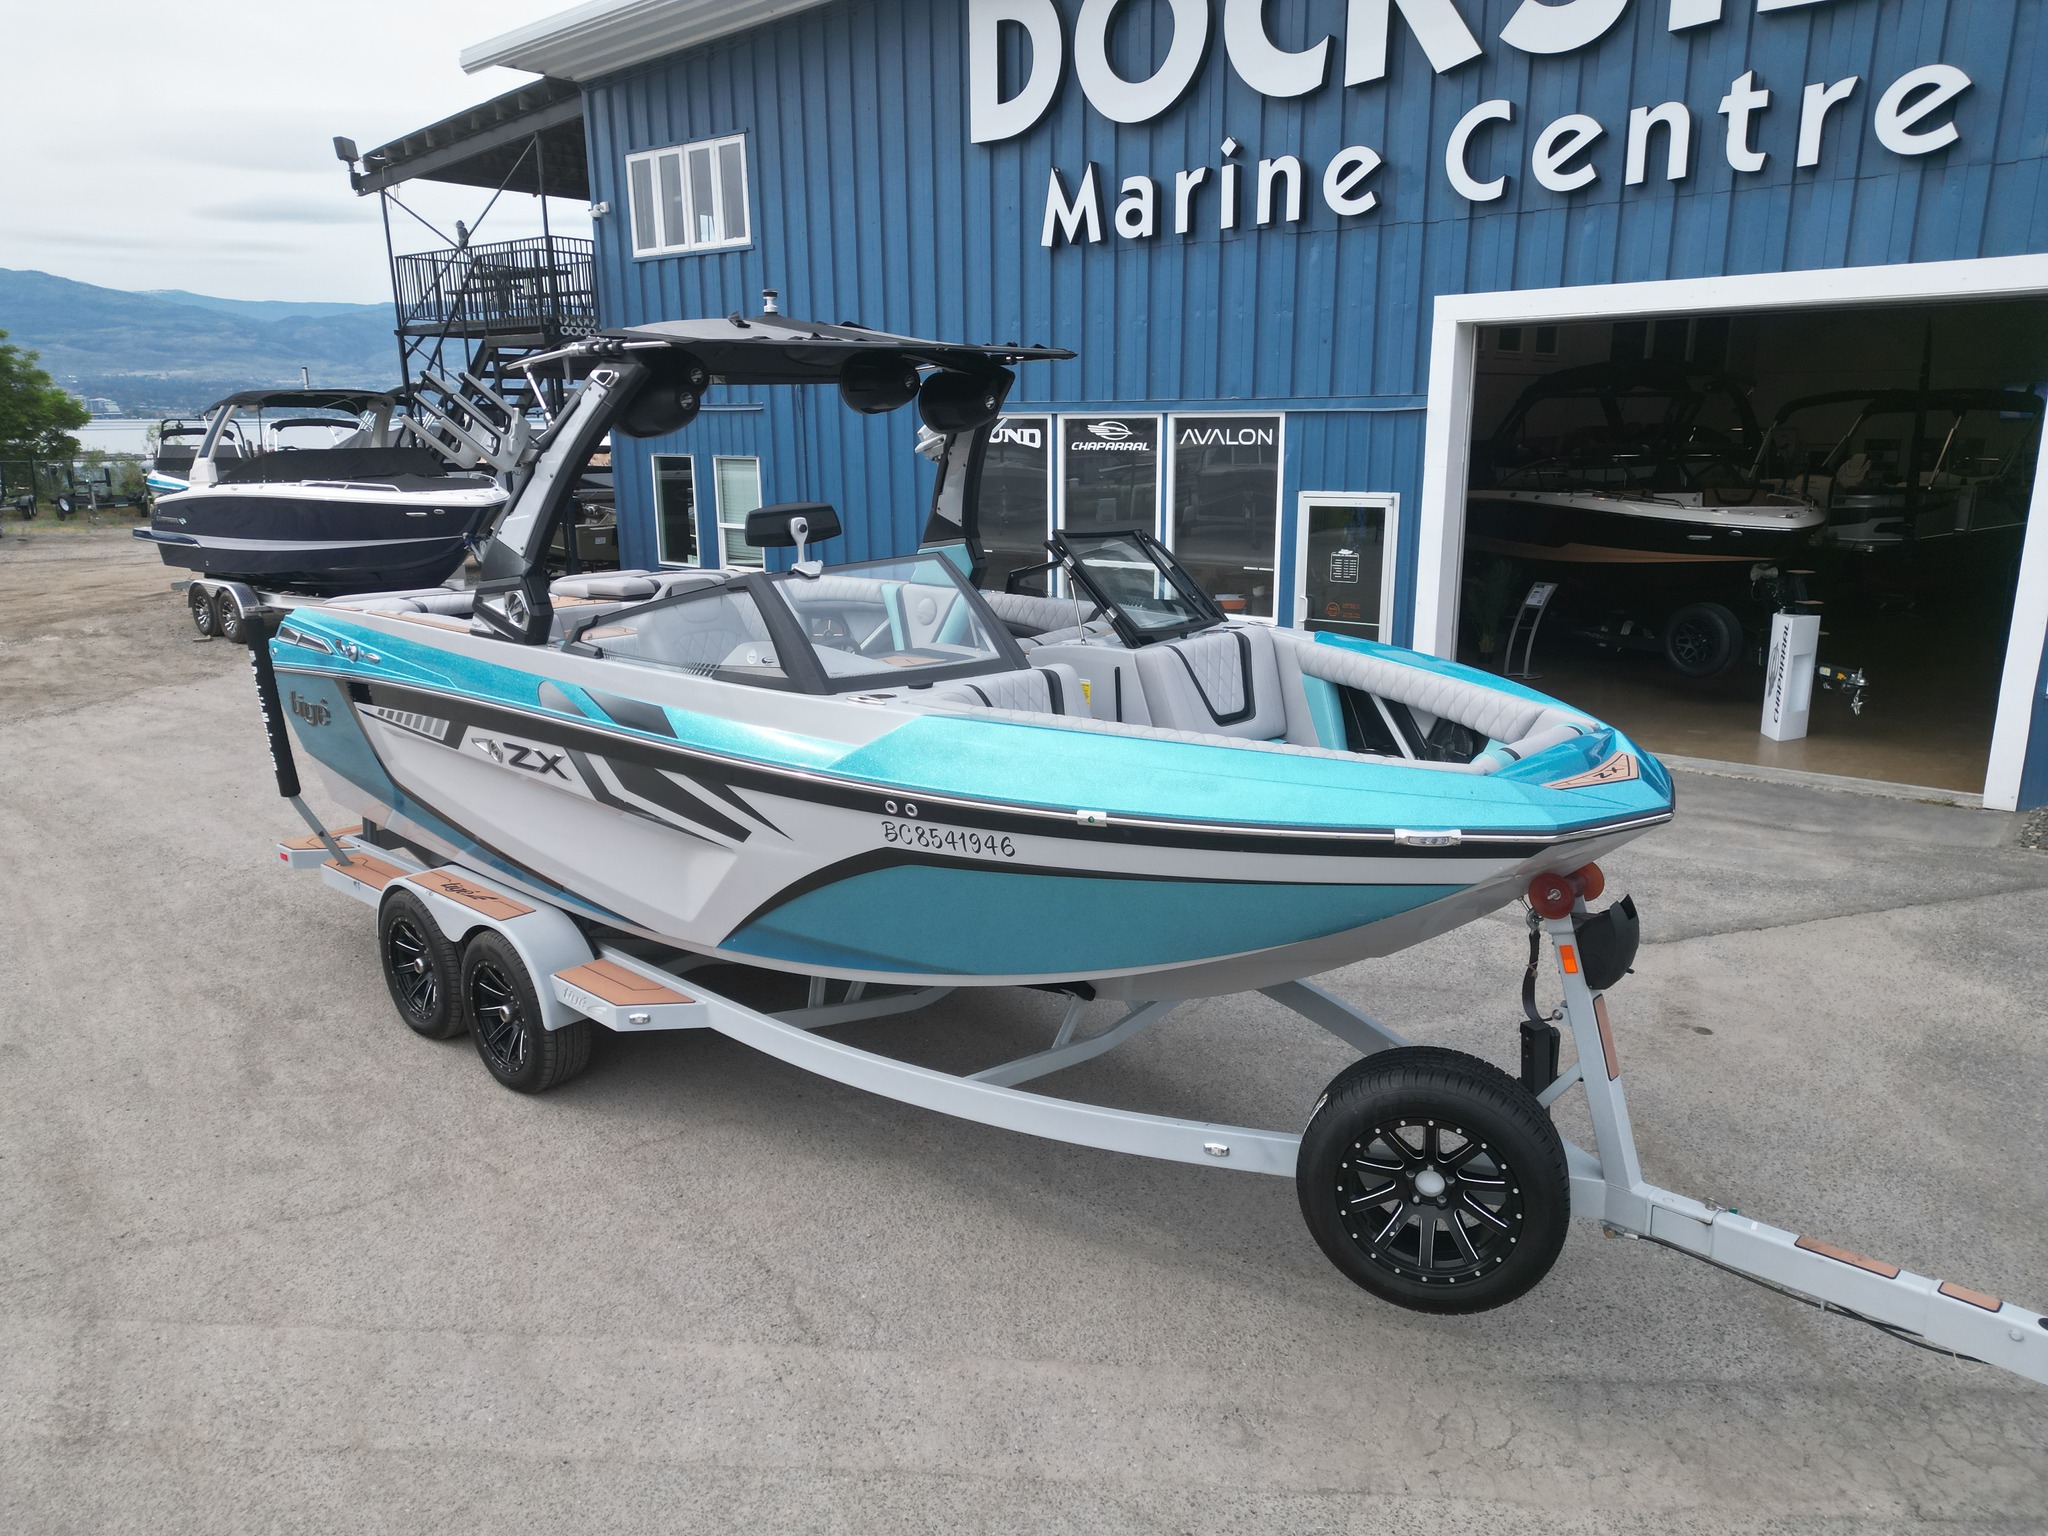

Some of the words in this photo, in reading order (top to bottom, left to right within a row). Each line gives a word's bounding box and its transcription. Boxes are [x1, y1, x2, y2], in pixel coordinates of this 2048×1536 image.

[1041, 137, 1383, 249] Marine
[1446, 64, 1974, 202] Centre
[1070, 441, 1151, 452] CHAPARRAL
[1179, 428, 1274, 446] AVALON
[1772, 622, 1792, 725] CHAPARRAL
[881, 820, 1017, 858] BC8541946
